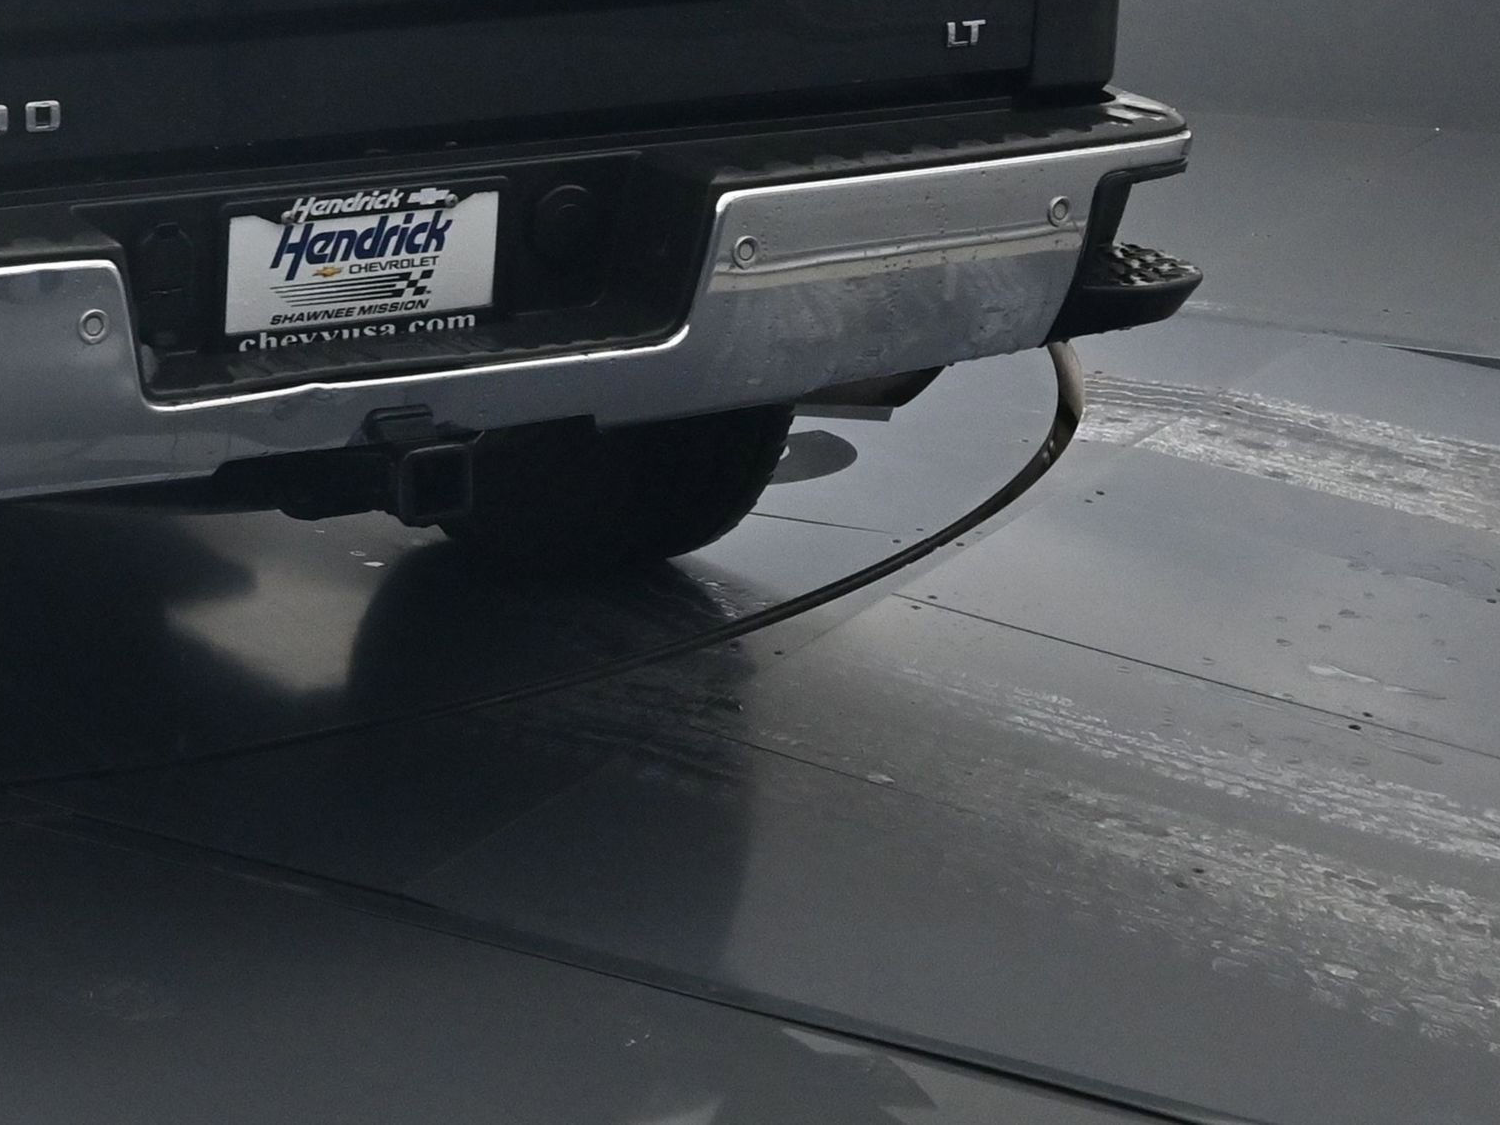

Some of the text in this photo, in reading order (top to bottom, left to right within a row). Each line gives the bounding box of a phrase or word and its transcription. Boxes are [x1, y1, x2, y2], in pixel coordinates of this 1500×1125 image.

[946, 19, 987, 48] LT
[291, 188, 405, 223] Hendrick
[269, 210, 454, 282] Hendrick
[349, 255, 440, 275] CHEVROLET
[270, 298, 430, 326] SHAWNEE MISSION
[238, 313, 477, 353] chevyusacom
